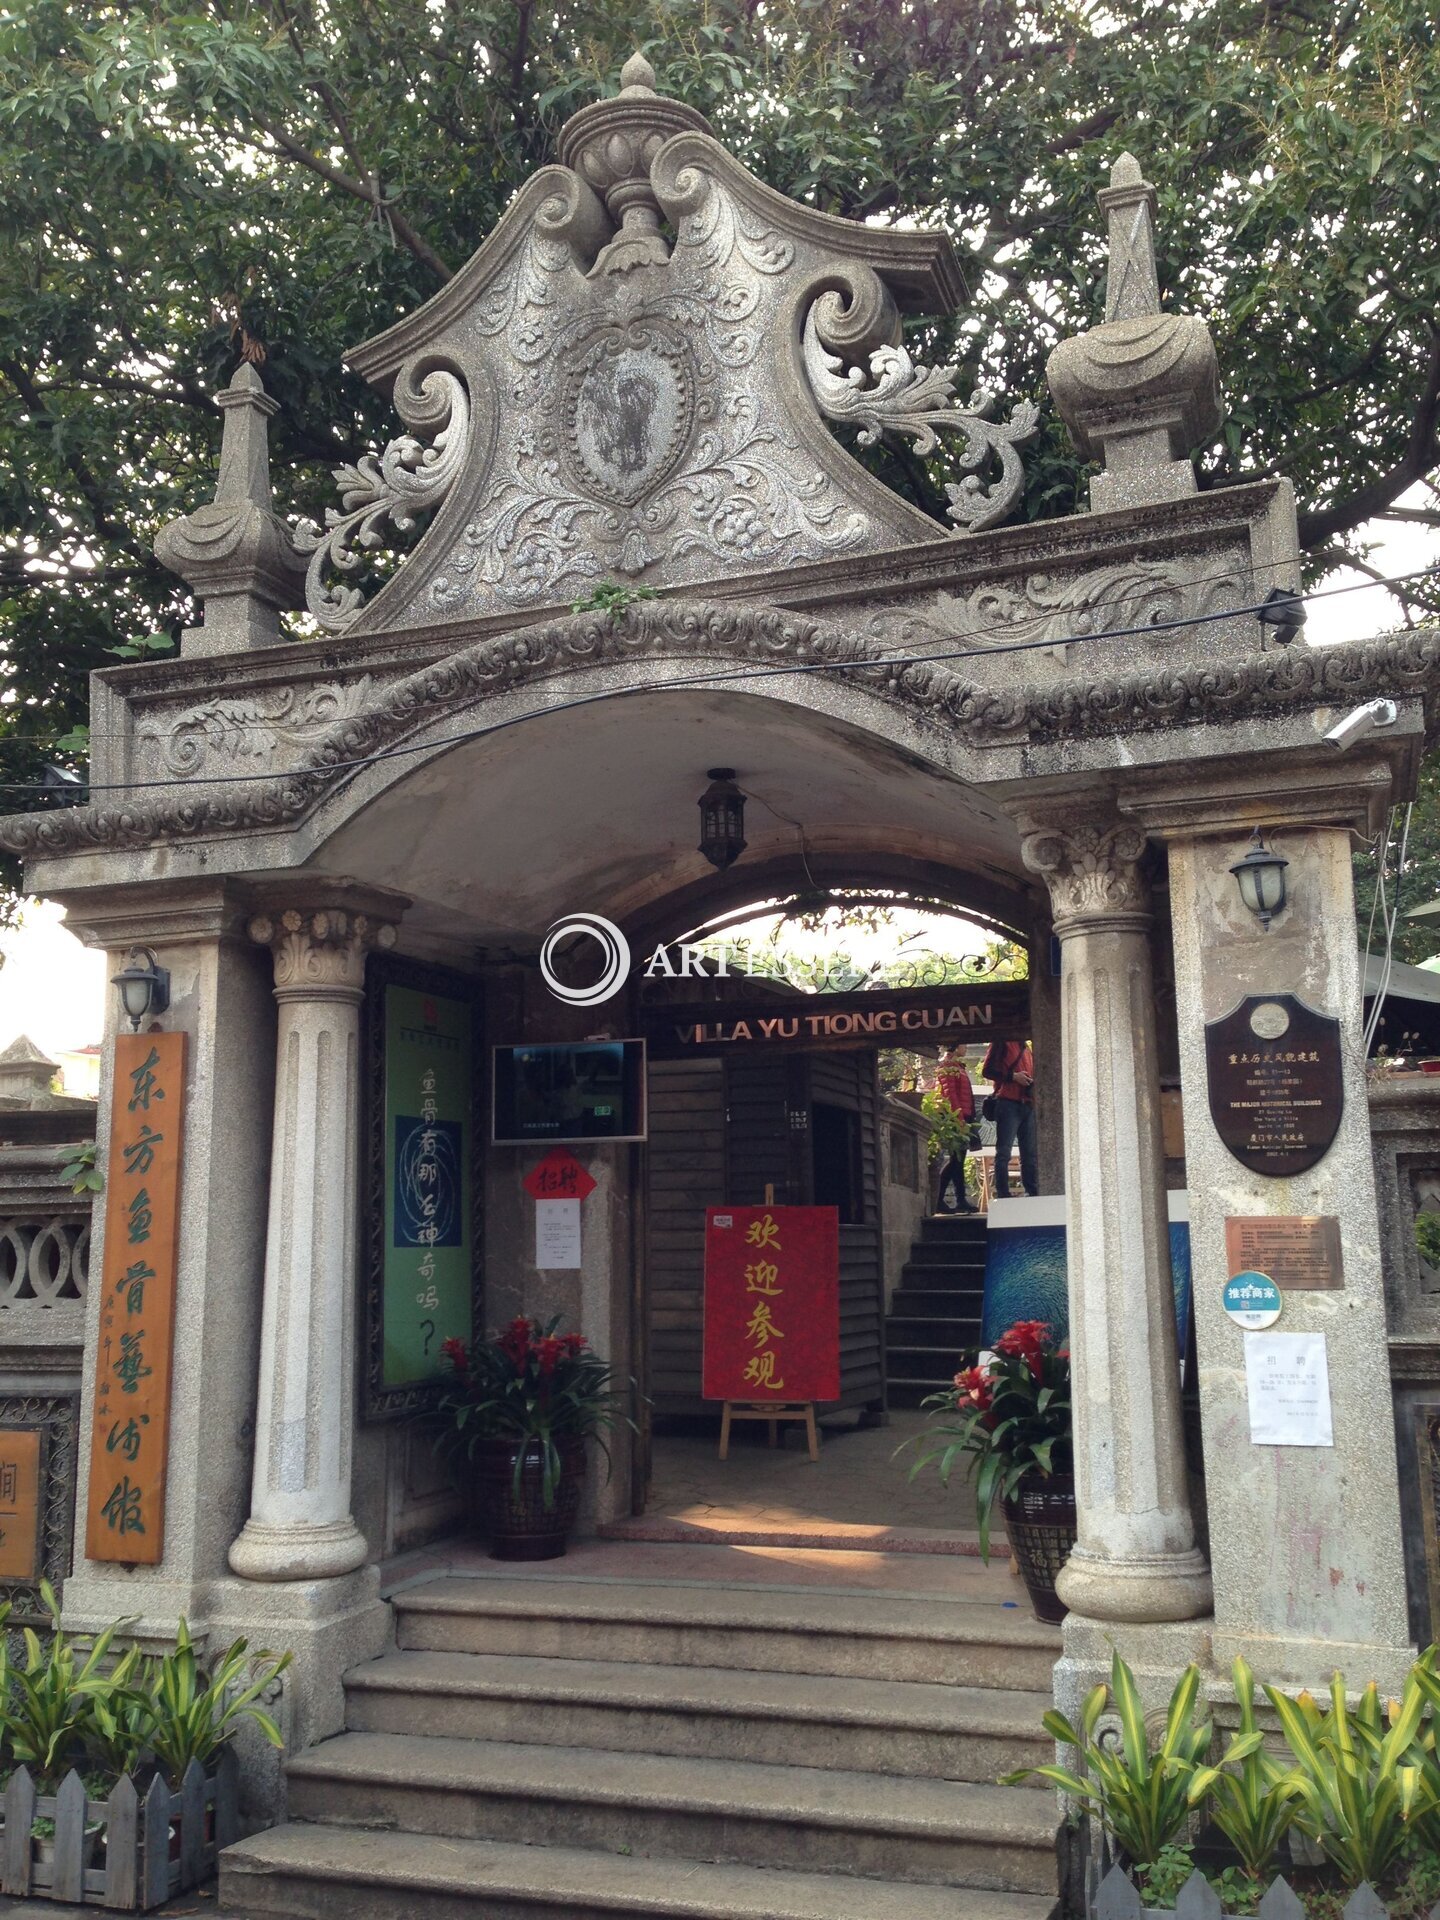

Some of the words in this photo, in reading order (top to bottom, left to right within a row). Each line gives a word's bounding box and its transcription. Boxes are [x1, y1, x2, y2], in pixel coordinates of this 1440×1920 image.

[675, 1021, 752, 1044] VILLA
[757, 1018, 799, 1038] YU
[805, 1011, 897, 1036] TIONG
[902, 1004, 992, 1029] CUAN
[743, 1214, 785, 1390] 欢迎参观
[1228, 1287, 1275, 1299] 推荐商家
